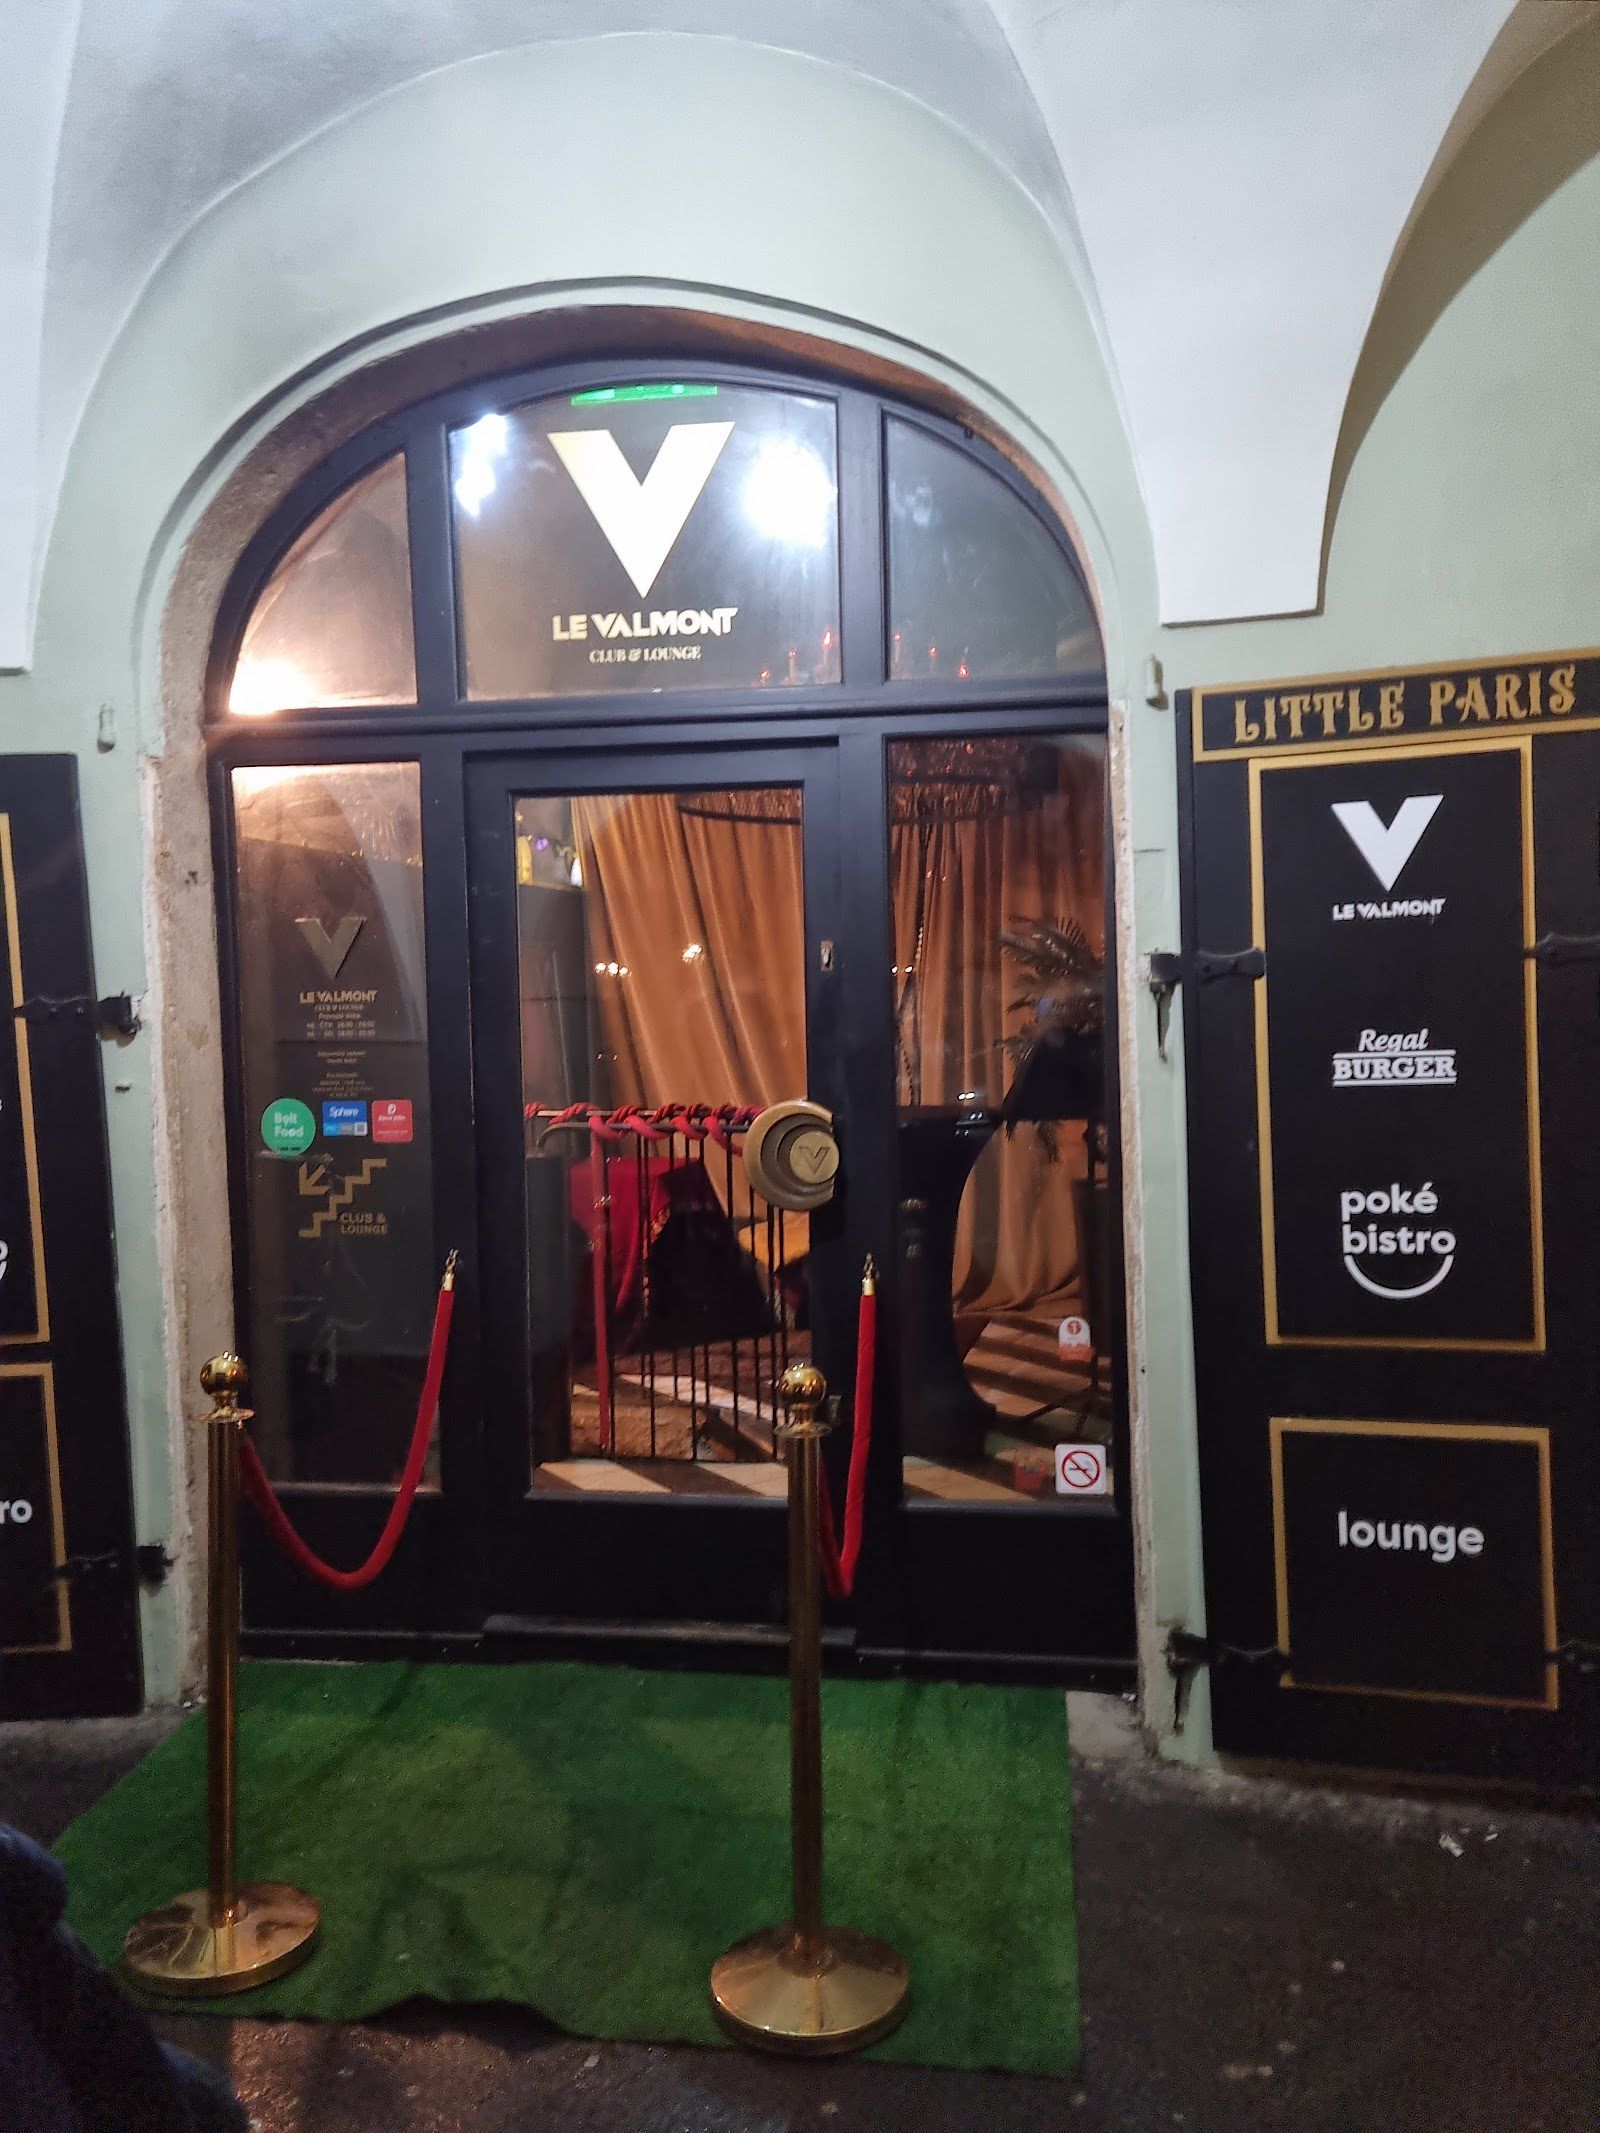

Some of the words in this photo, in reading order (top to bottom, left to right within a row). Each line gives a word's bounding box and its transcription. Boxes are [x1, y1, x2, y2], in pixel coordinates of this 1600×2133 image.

[552, 614, 588, 641] LE
[591, 607, 739, 639] VALMONT
[589, 648, 627, 664] CLUB
[628, 647, 642, 662] &
[642, 646, 702, 662] LOUNGE
[1234, 680, 1406, 744] LITTLE
[1429, 664, 1577, 726] PARIS
[1333, 903, 1356, 921] LE
[1356, 898, 1447, 919] VALMONT
[299, 991, 315, 1004] LE
[316, 989, 379, 1003] VALMONT
[1358, 1028, 1429, 1052] Regal
[1333, 1056, 1458, 1080] BURGER
[274, 1112, 298, 1126] Bolt
[329, 1106, 360, 1118] Sphere
[274, 1126, 305, 1138] Food
[1341, 1182, 1439, 1222] poké
[340, 1212, 374, 1224] CLUB
[341, 1224, 388, 1236] LOUNGE
[1343, 1223, 1457, 1254] bistro
[1338, 1510, 1485, 1563] lounge
